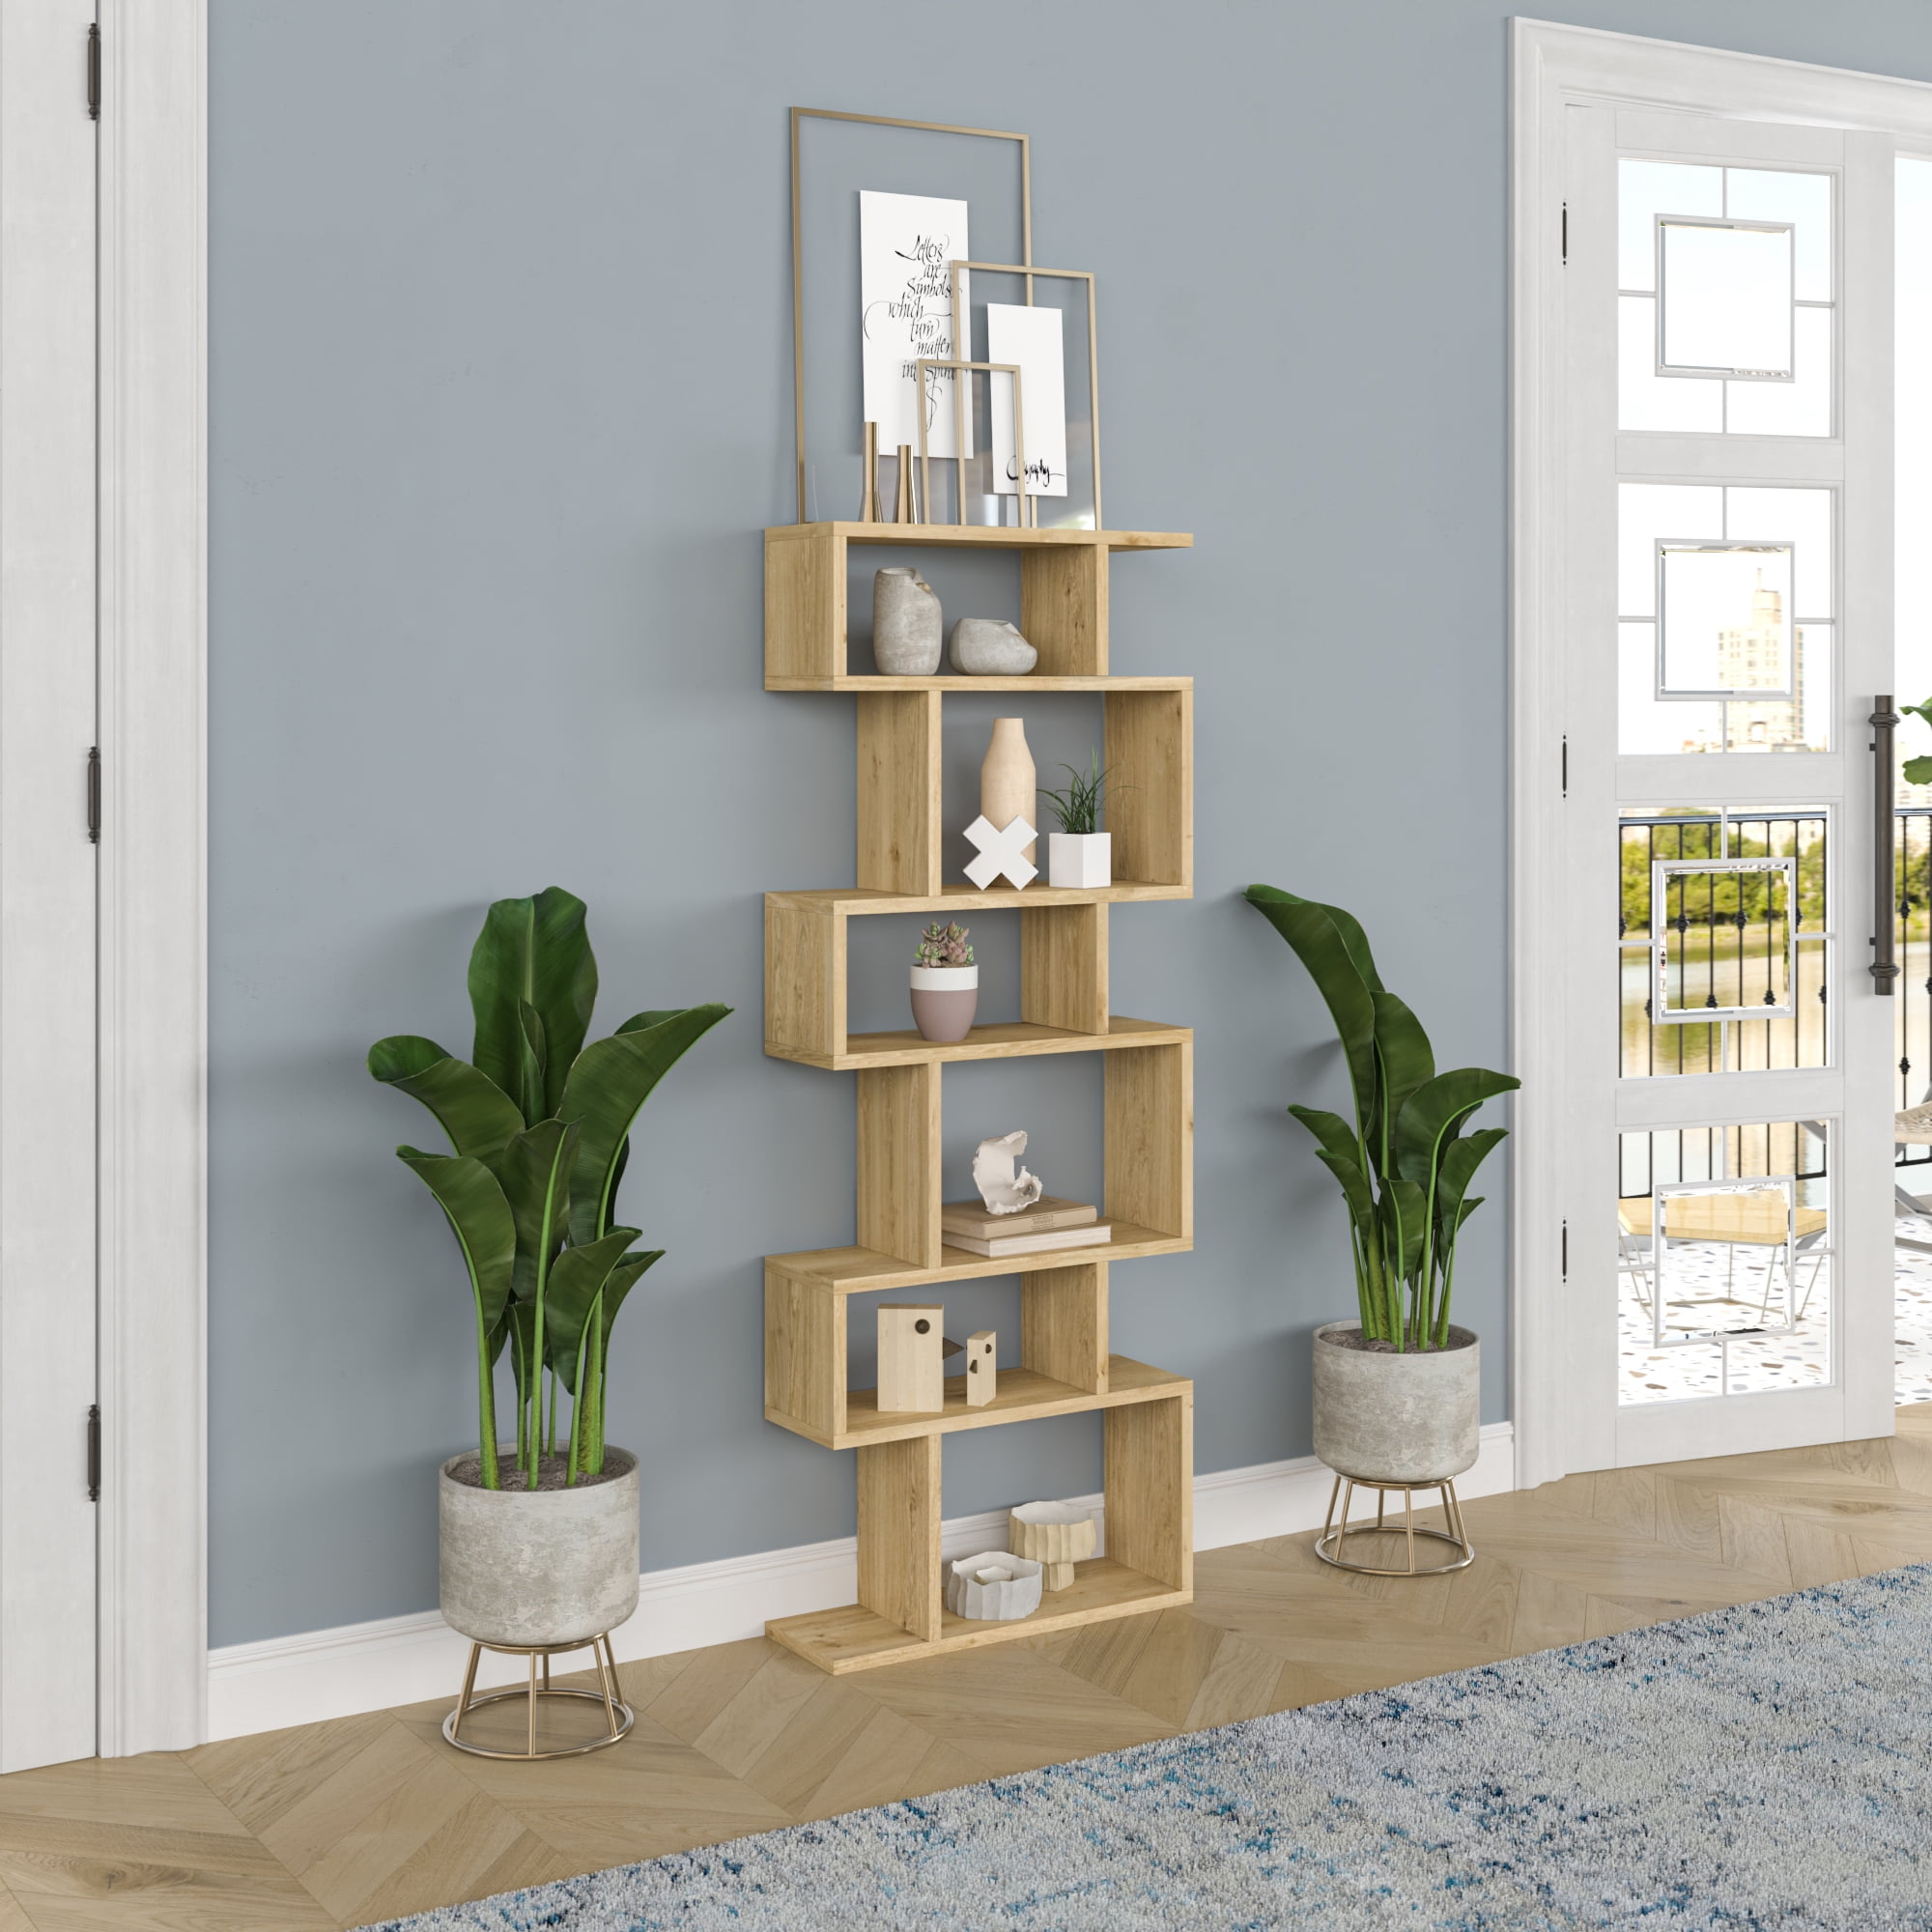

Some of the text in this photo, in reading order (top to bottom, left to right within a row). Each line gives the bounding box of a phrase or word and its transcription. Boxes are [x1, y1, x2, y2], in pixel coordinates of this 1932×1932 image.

[895, 235, 950, 266] Letters
[923, 264, 944, 279] are
[910, 318, 939, 342] turn
[915, 334, 951, 361] matter
[902, 359, 917, 383] int
